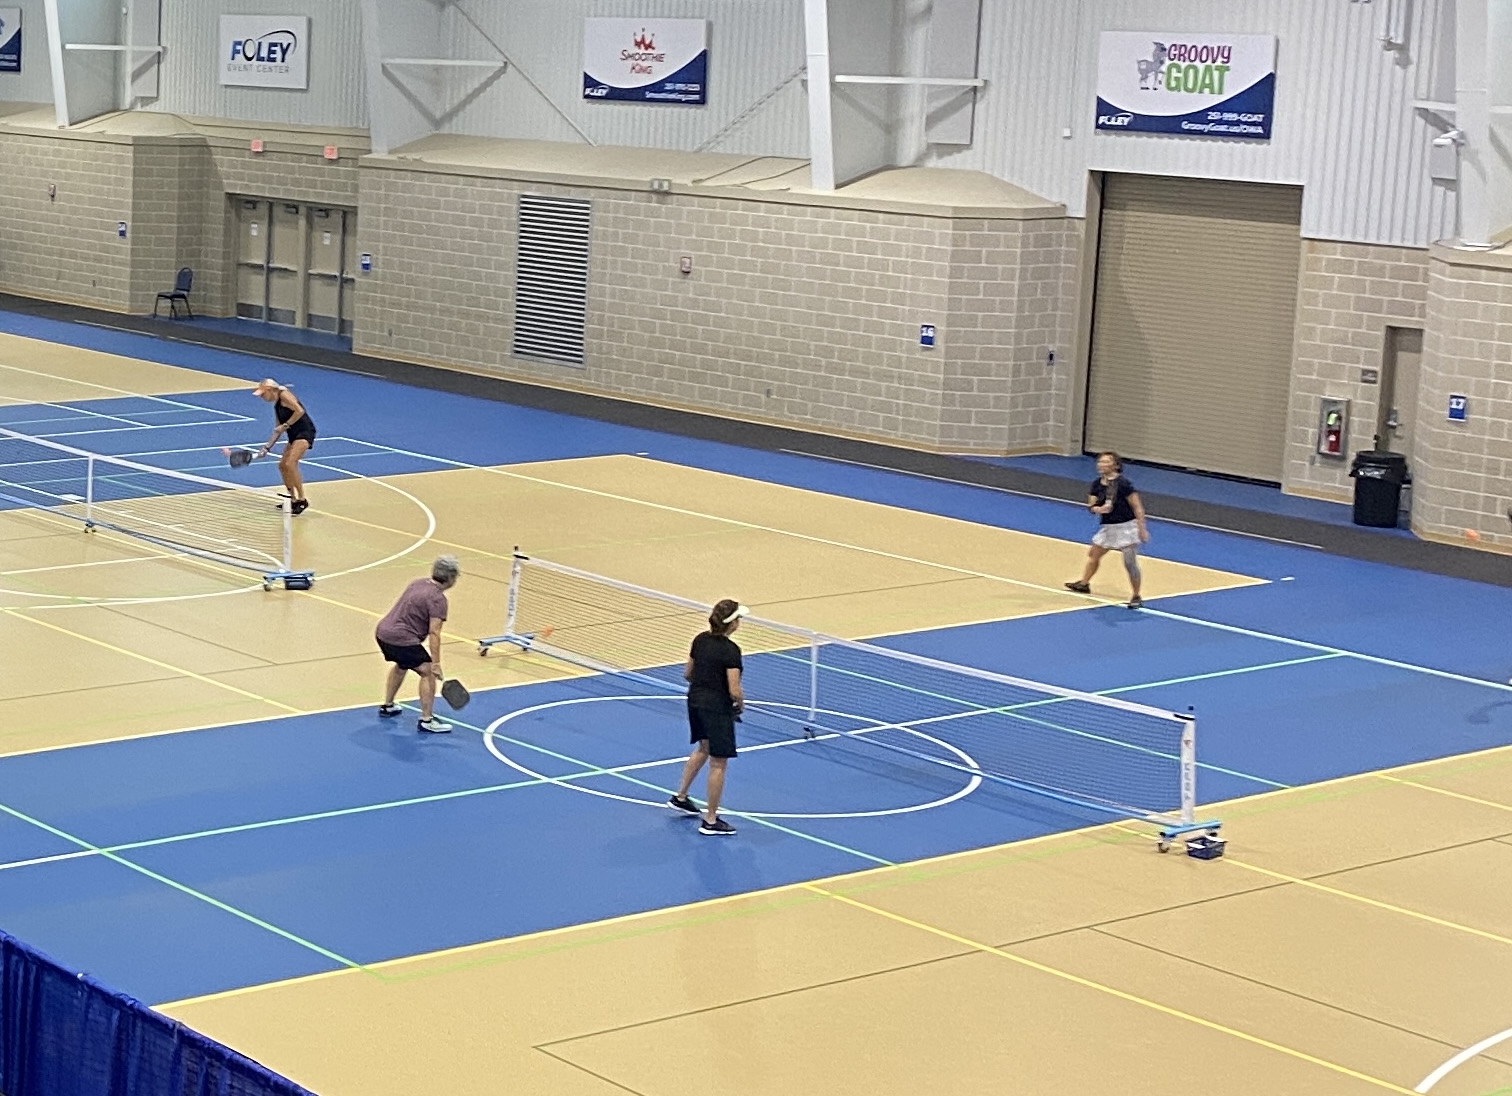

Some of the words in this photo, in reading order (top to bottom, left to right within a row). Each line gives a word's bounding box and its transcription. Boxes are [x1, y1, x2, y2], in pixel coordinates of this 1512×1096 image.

[231, 39, 291, 63] FOLEY
[1167, 43, 1233, 64] GROOVY
[227, 64, 254, 72] EVENT
[256, 65, 290, 74] CENTER
[1165, 62, 1231, 95] GOAT
